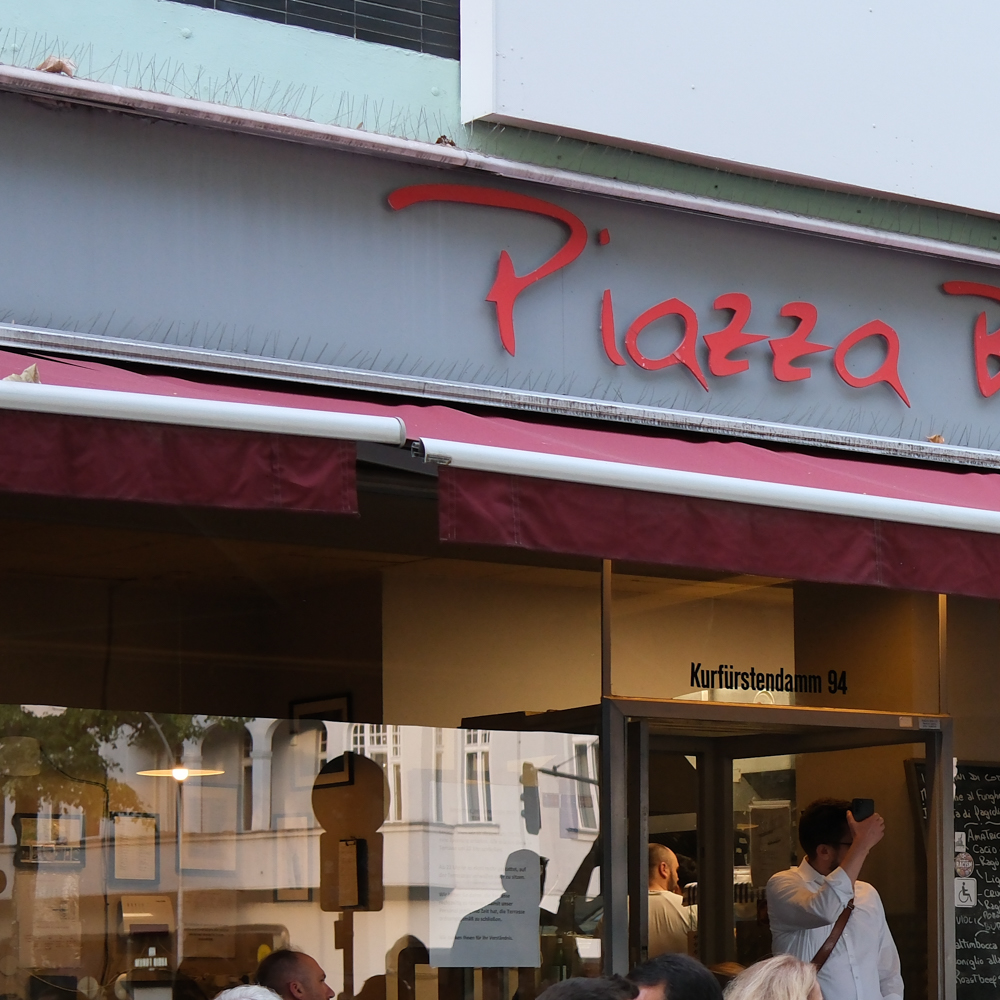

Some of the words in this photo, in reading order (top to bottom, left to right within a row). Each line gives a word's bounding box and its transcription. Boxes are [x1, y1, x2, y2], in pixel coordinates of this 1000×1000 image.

[387, 184, 910, 408] Piazza
[690, 662, 822, 694] Kurfürstendamm
[828, 669, 848, 695] 94
